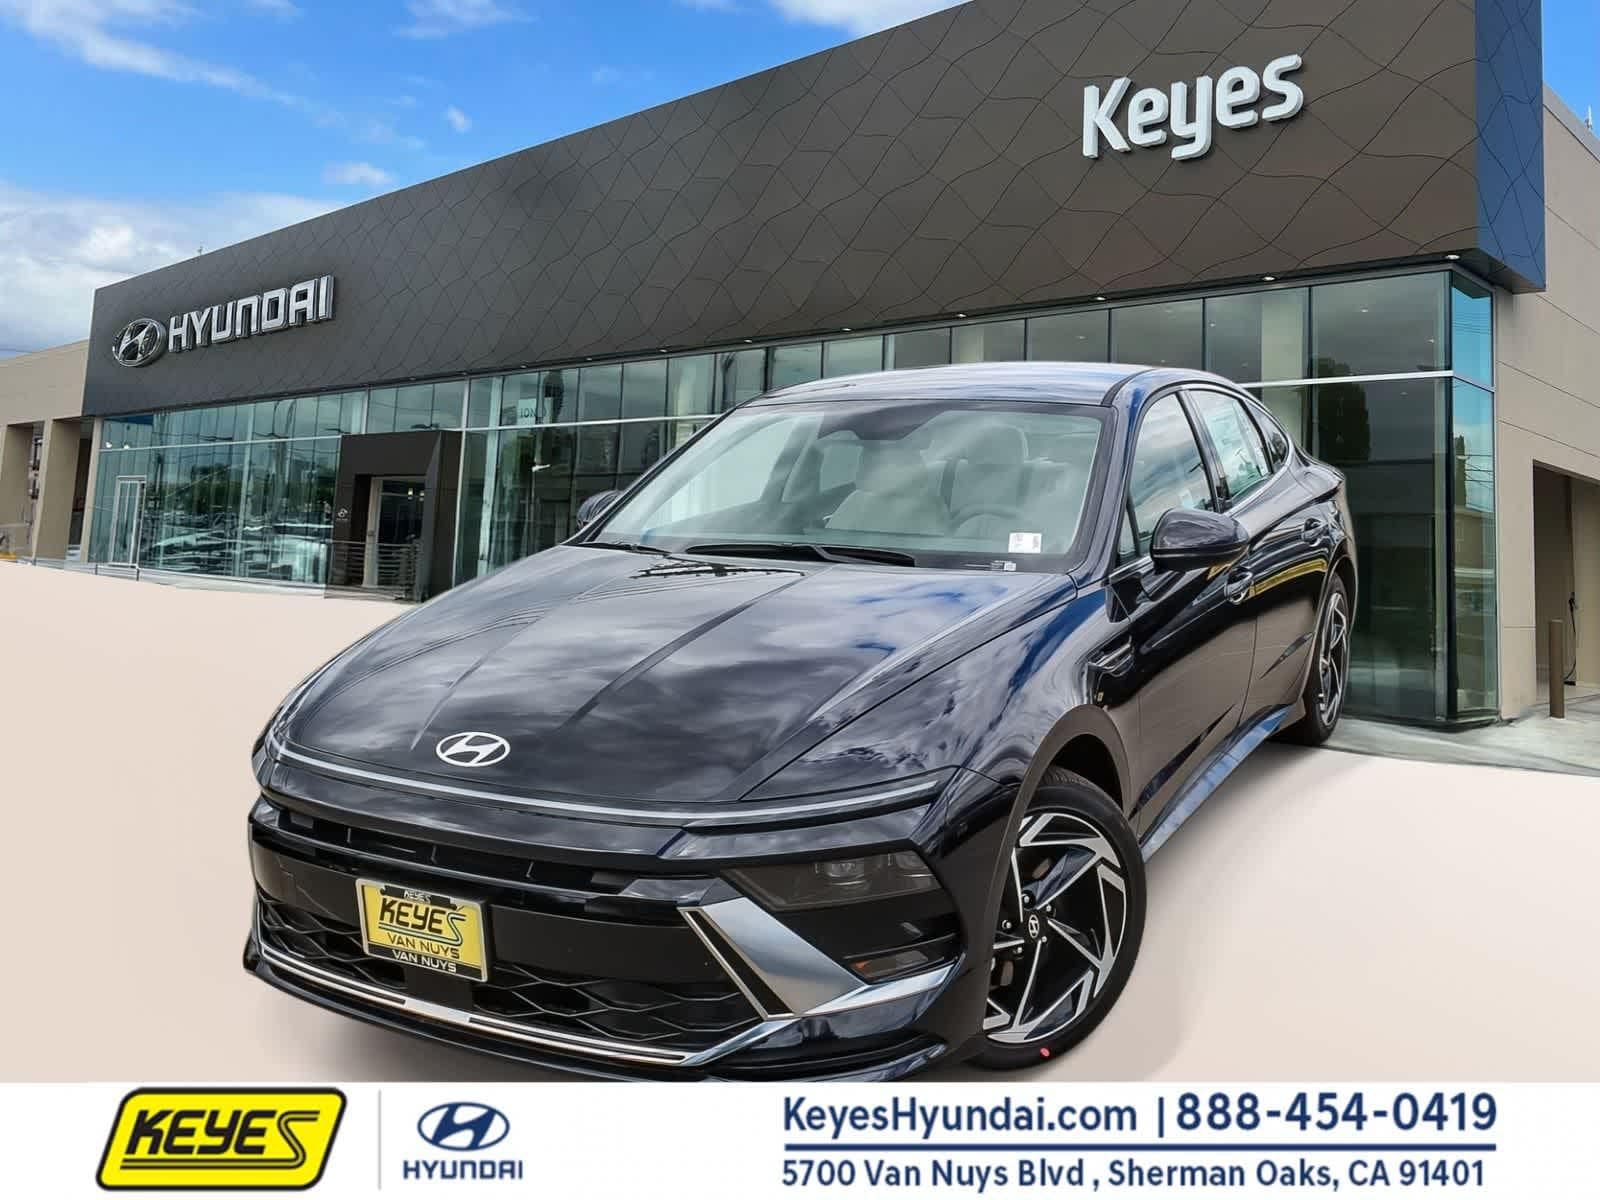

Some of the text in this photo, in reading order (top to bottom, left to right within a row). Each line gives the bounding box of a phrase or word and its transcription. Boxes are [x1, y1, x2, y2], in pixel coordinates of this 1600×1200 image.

[1083, 54, 1304, 160] Keyes
[168, 275, 335, 352] HYUNDAI
[404, 889, 432, 904] KEYES
[379, 897, 466, 946] KEYES
[387, 932, 460, 960] VAN NUYS
[392, 949, 457, 973] VAN NUYS
